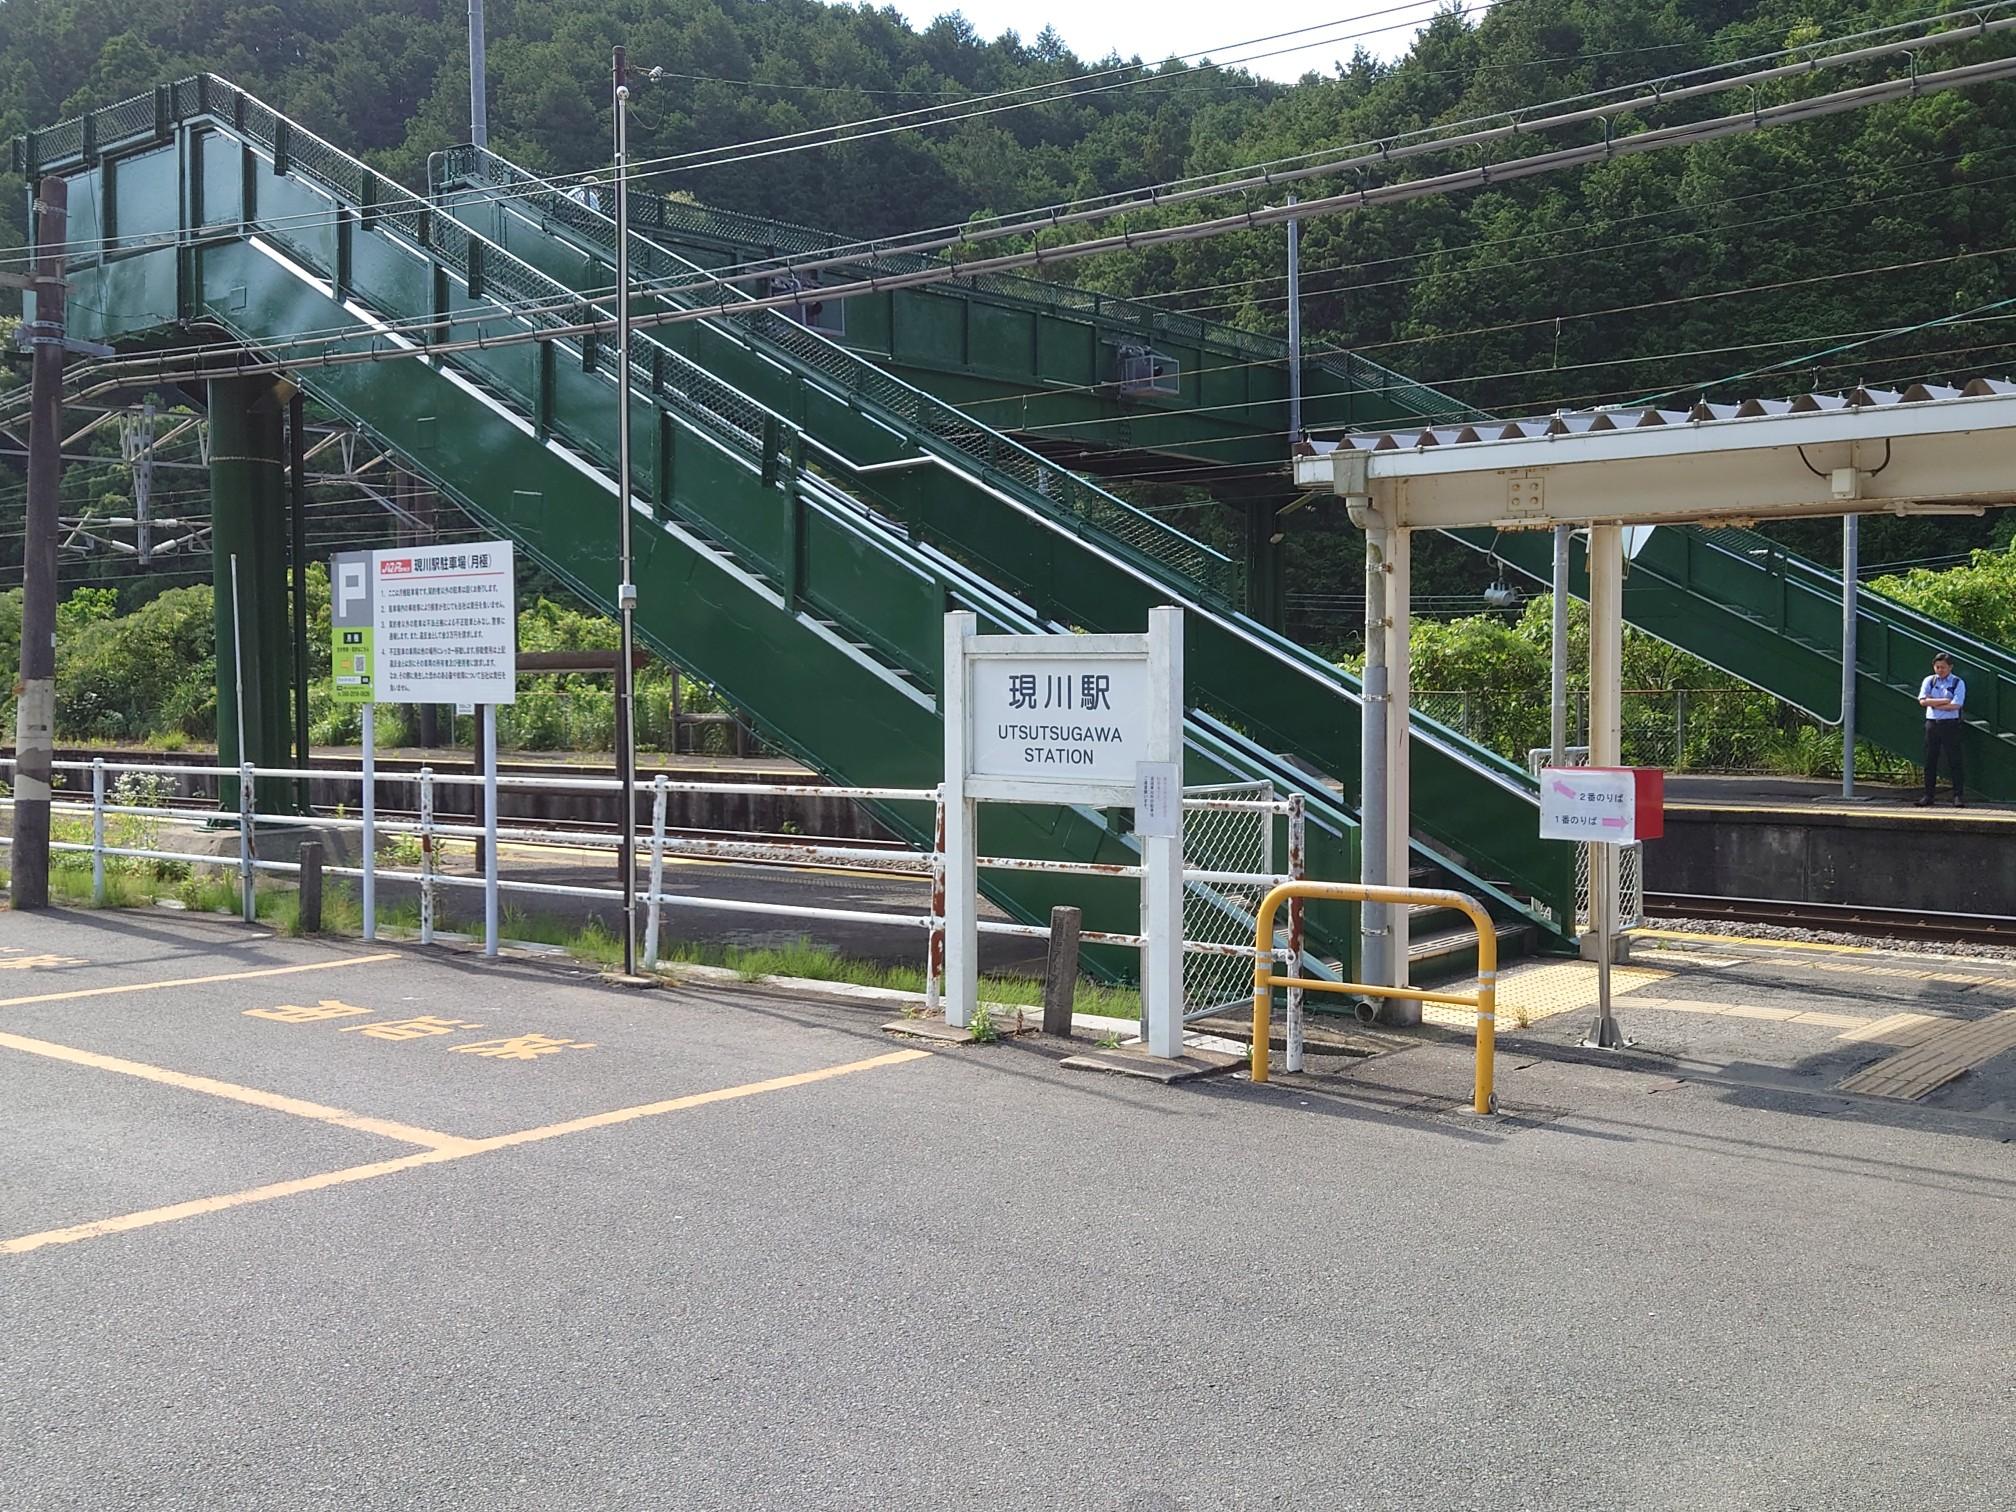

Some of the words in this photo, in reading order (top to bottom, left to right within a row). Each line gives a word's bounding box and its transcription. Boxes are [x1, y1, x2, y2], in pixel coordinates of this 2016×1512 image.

[1008, 674, 1111, 711] 現川駅
[998, 724, 1123, 743] UTSUTSUGAWA
[1024, 747, 1094, 765] STATION
[1579, 792, 1624, 803] 2番のりば
[1555, 815, 1598, 826] 1番のりば
